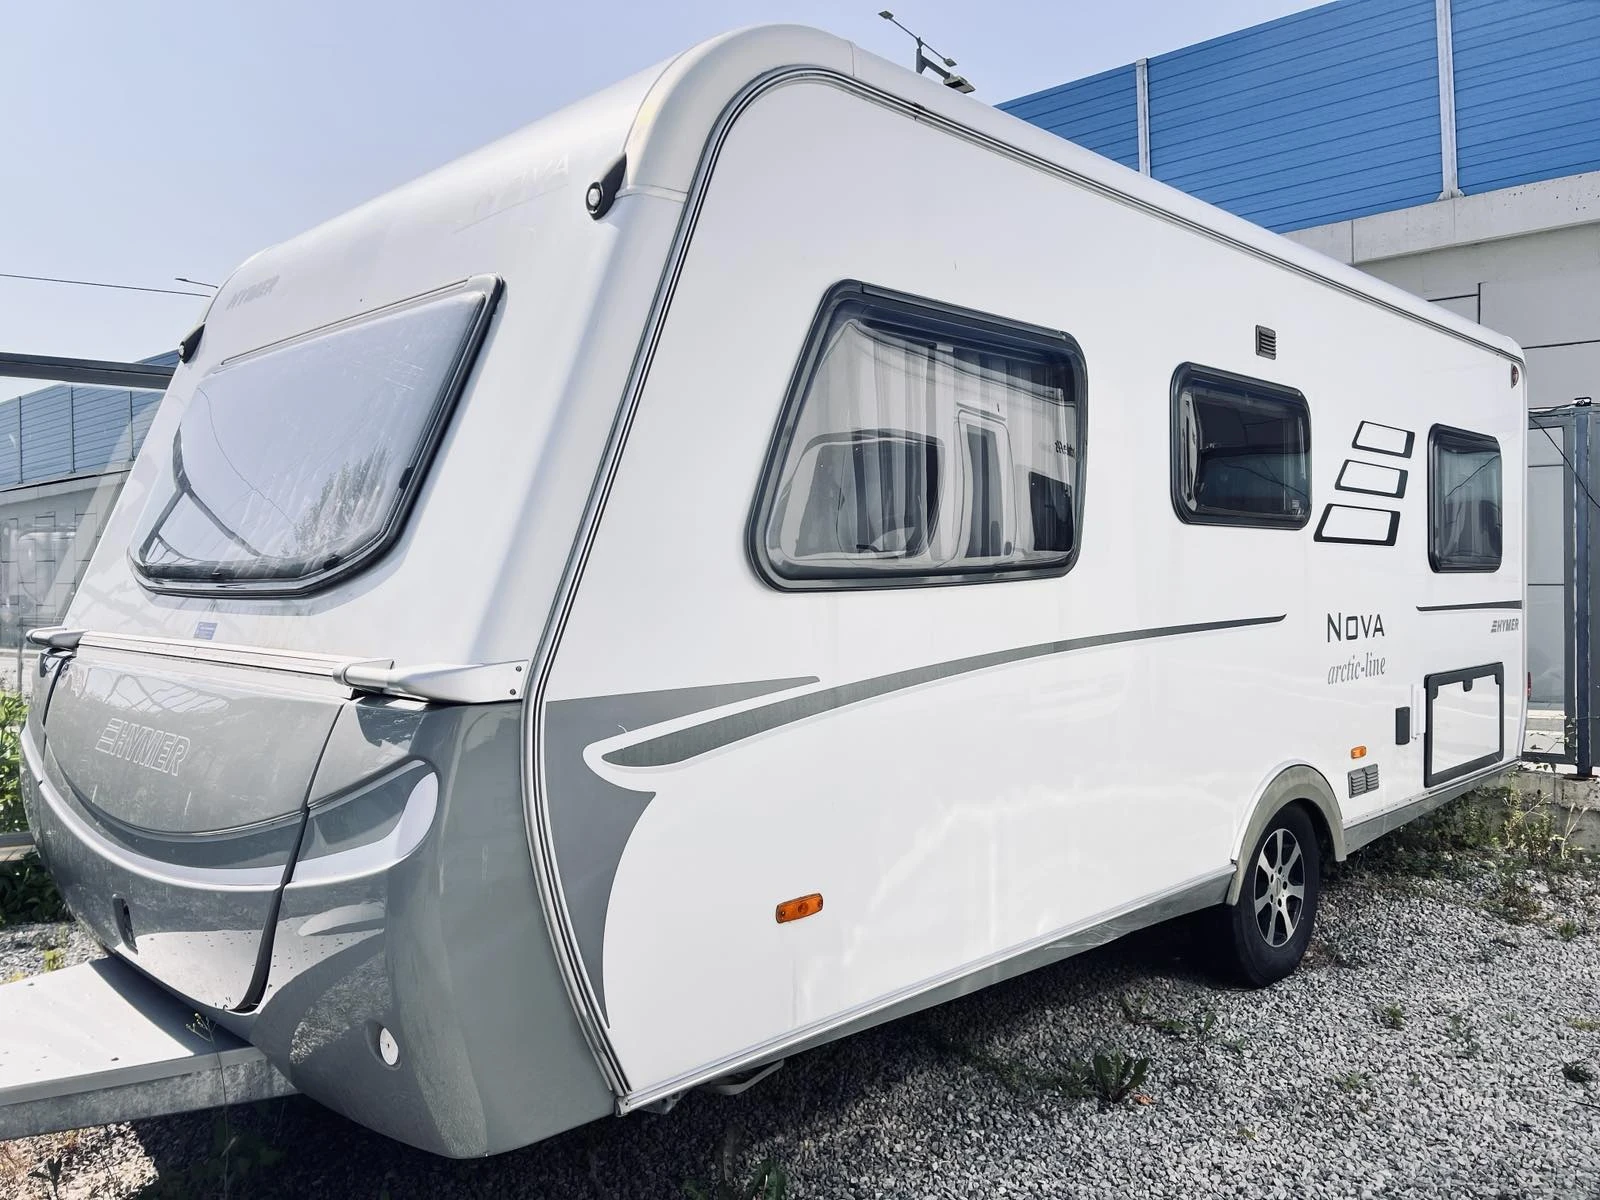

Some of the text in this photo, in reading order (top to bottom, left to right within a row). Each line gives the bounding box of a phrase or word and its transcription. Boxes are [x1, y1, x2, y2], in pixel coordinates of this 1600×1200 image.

[1496, 617, 1520, 633] HYMER
[1327, 652, 1386, 685] arctic-line
[110, 720, 191, 777] HYMER
